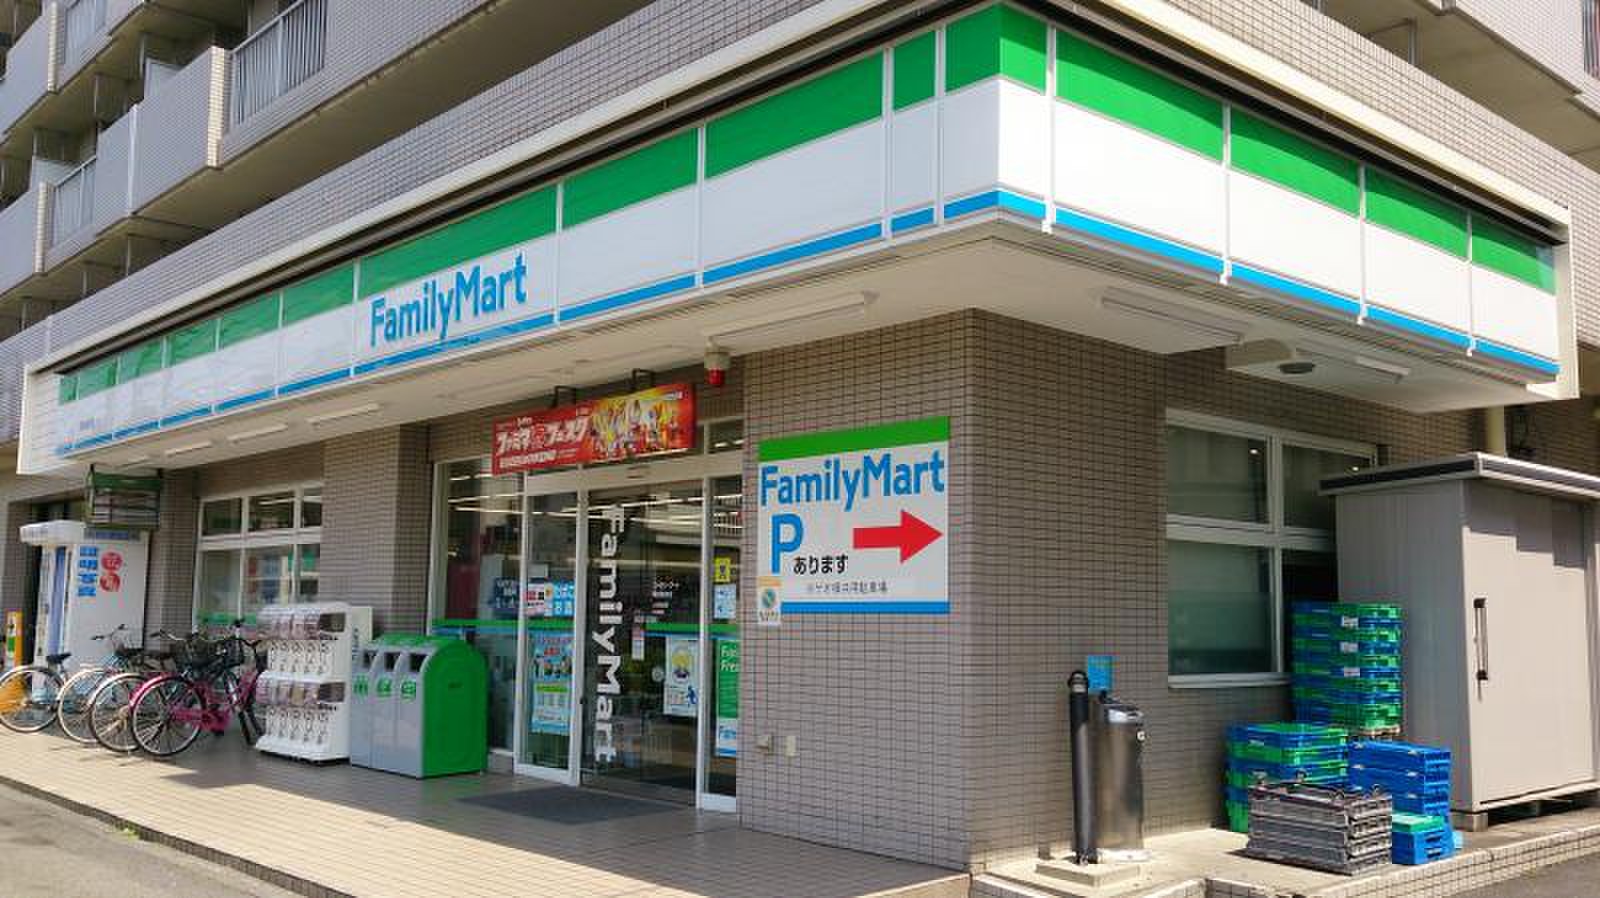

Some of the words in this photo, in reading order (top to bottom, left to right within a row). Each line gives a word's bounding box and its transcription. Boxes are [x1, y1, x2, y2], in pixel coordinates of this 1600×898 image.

[370, 253, 527, 346] FamilyMart
[761, 450, 945, 511] FamilyMart
[771, 513, 804, 574] P
[793, 554, 849, 575] あります
[592, 504, 625, 763] FamilyMart
